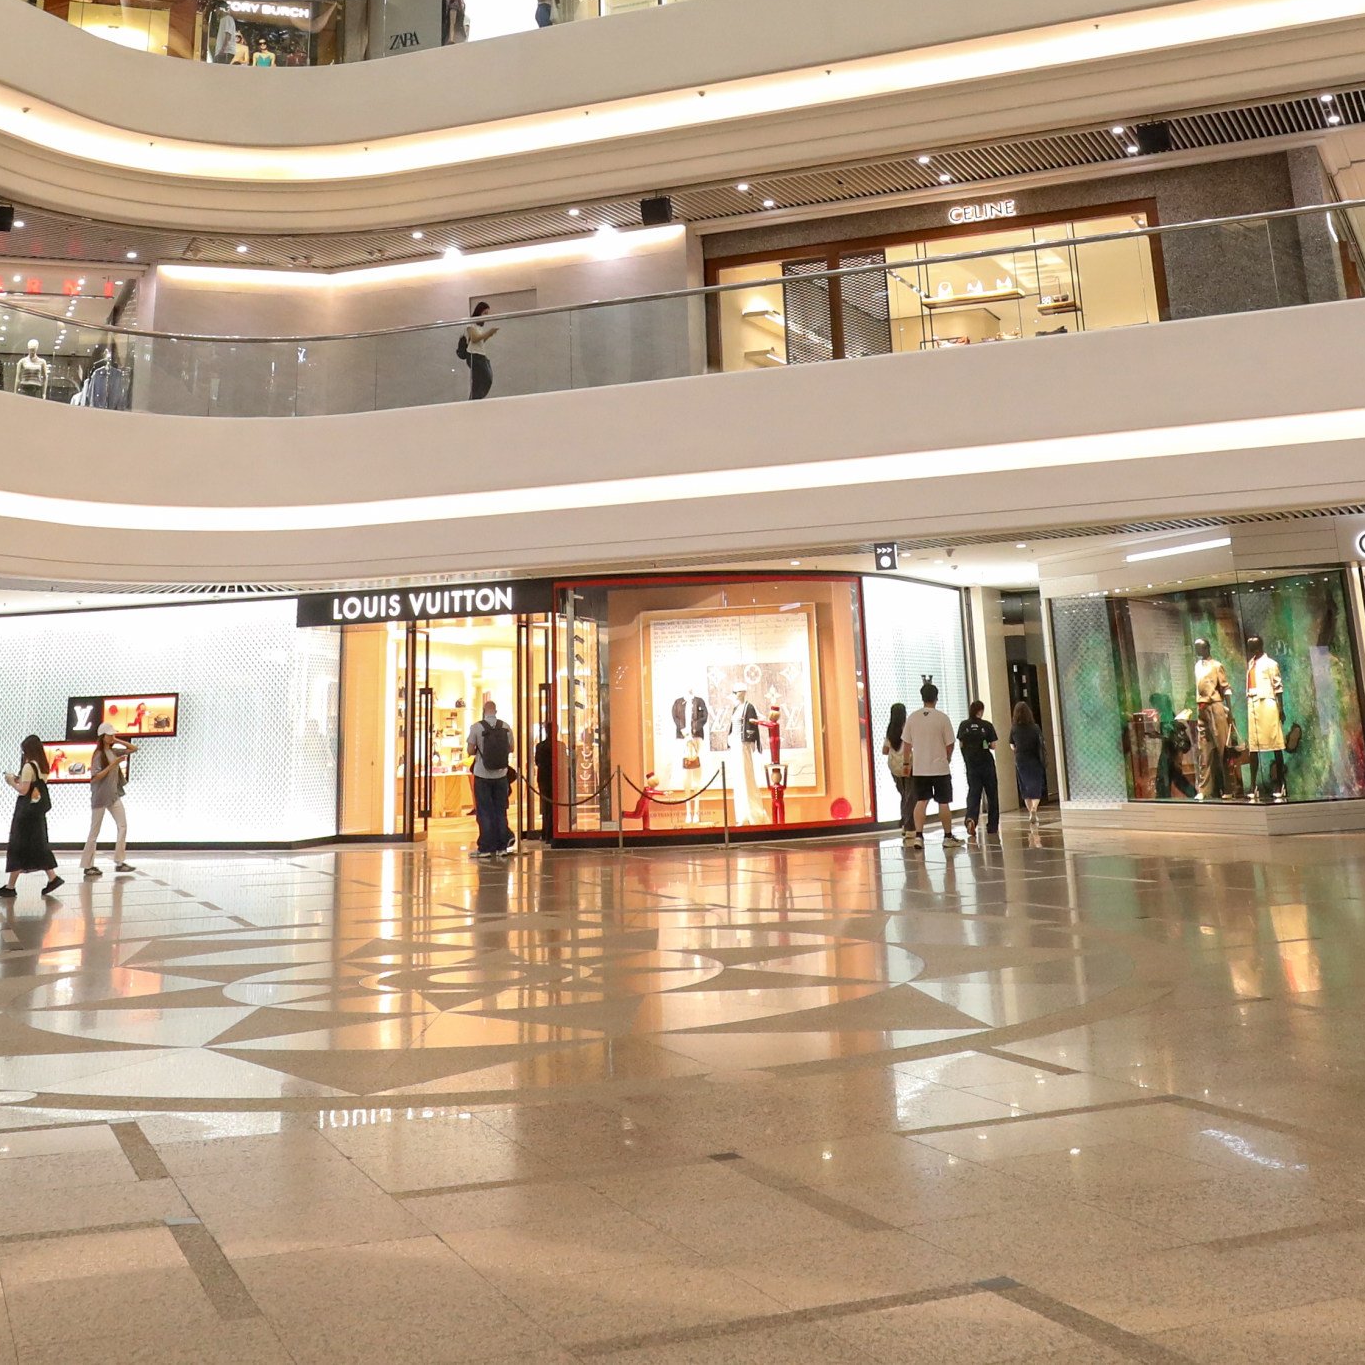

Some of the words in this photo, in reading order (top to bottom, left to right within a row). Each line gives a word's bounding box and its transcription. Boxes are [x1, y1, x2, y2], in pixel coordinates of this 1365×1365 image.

[261, 3, 310, 19] BURCH
[389, 31, 420, 51] ZARA
[948, 199, 1016, 224] CELINE
[332, 594, 402, 620] LOUIS
[408, 586, 513, 616] VUITTON
